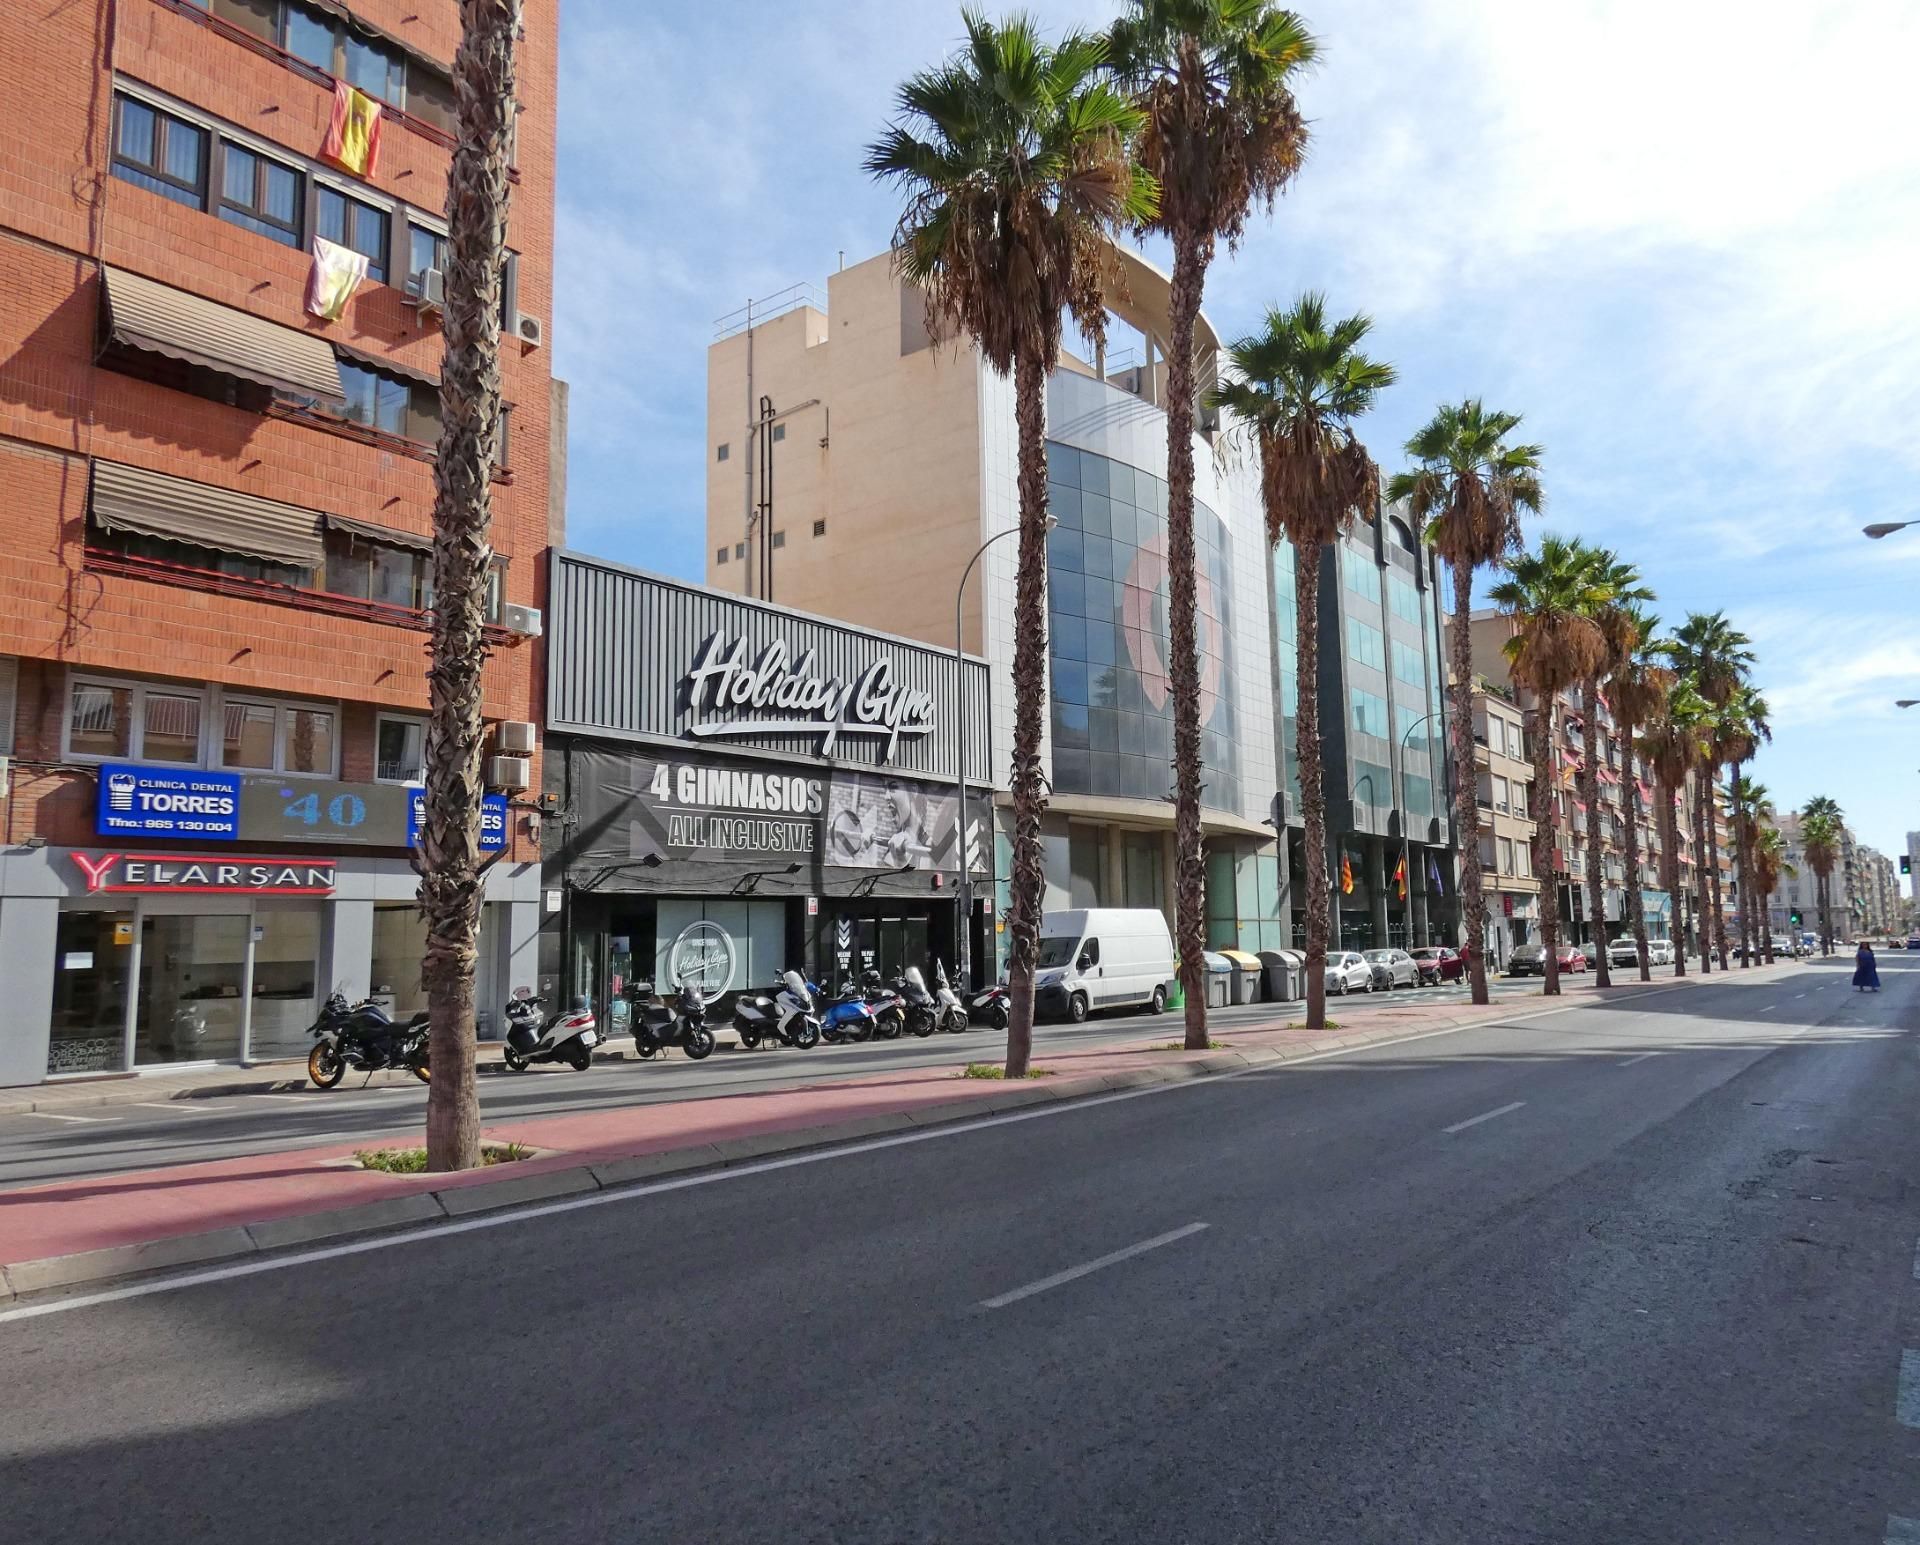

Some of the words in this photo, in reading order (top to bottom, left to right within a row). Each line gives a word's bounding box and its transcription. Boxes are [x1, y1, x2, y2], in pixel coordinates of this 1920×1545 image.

[691, 630, 852, 755] Holiday
[856, 657, 935, 760] Gym
[140, 779, 187, 790] CLINICA
[190, 783, 234, 793] DENTAL
[650, 764, 670, 801] 4
[677, 765, 822, 814] GIMNASIOS
[138, 793, 234, 815] TORRES
[283, 793, 367, 827] 40
[145, 820, 174, 829] 965
[176, 821, 203, 831] 130
[205, 822, 233, 832] 004
[668, 815, 706, 847] ALL
[710, 818, 814, 852] INCLUSIVE
[71, 852, 336, 890] YELARSAN
